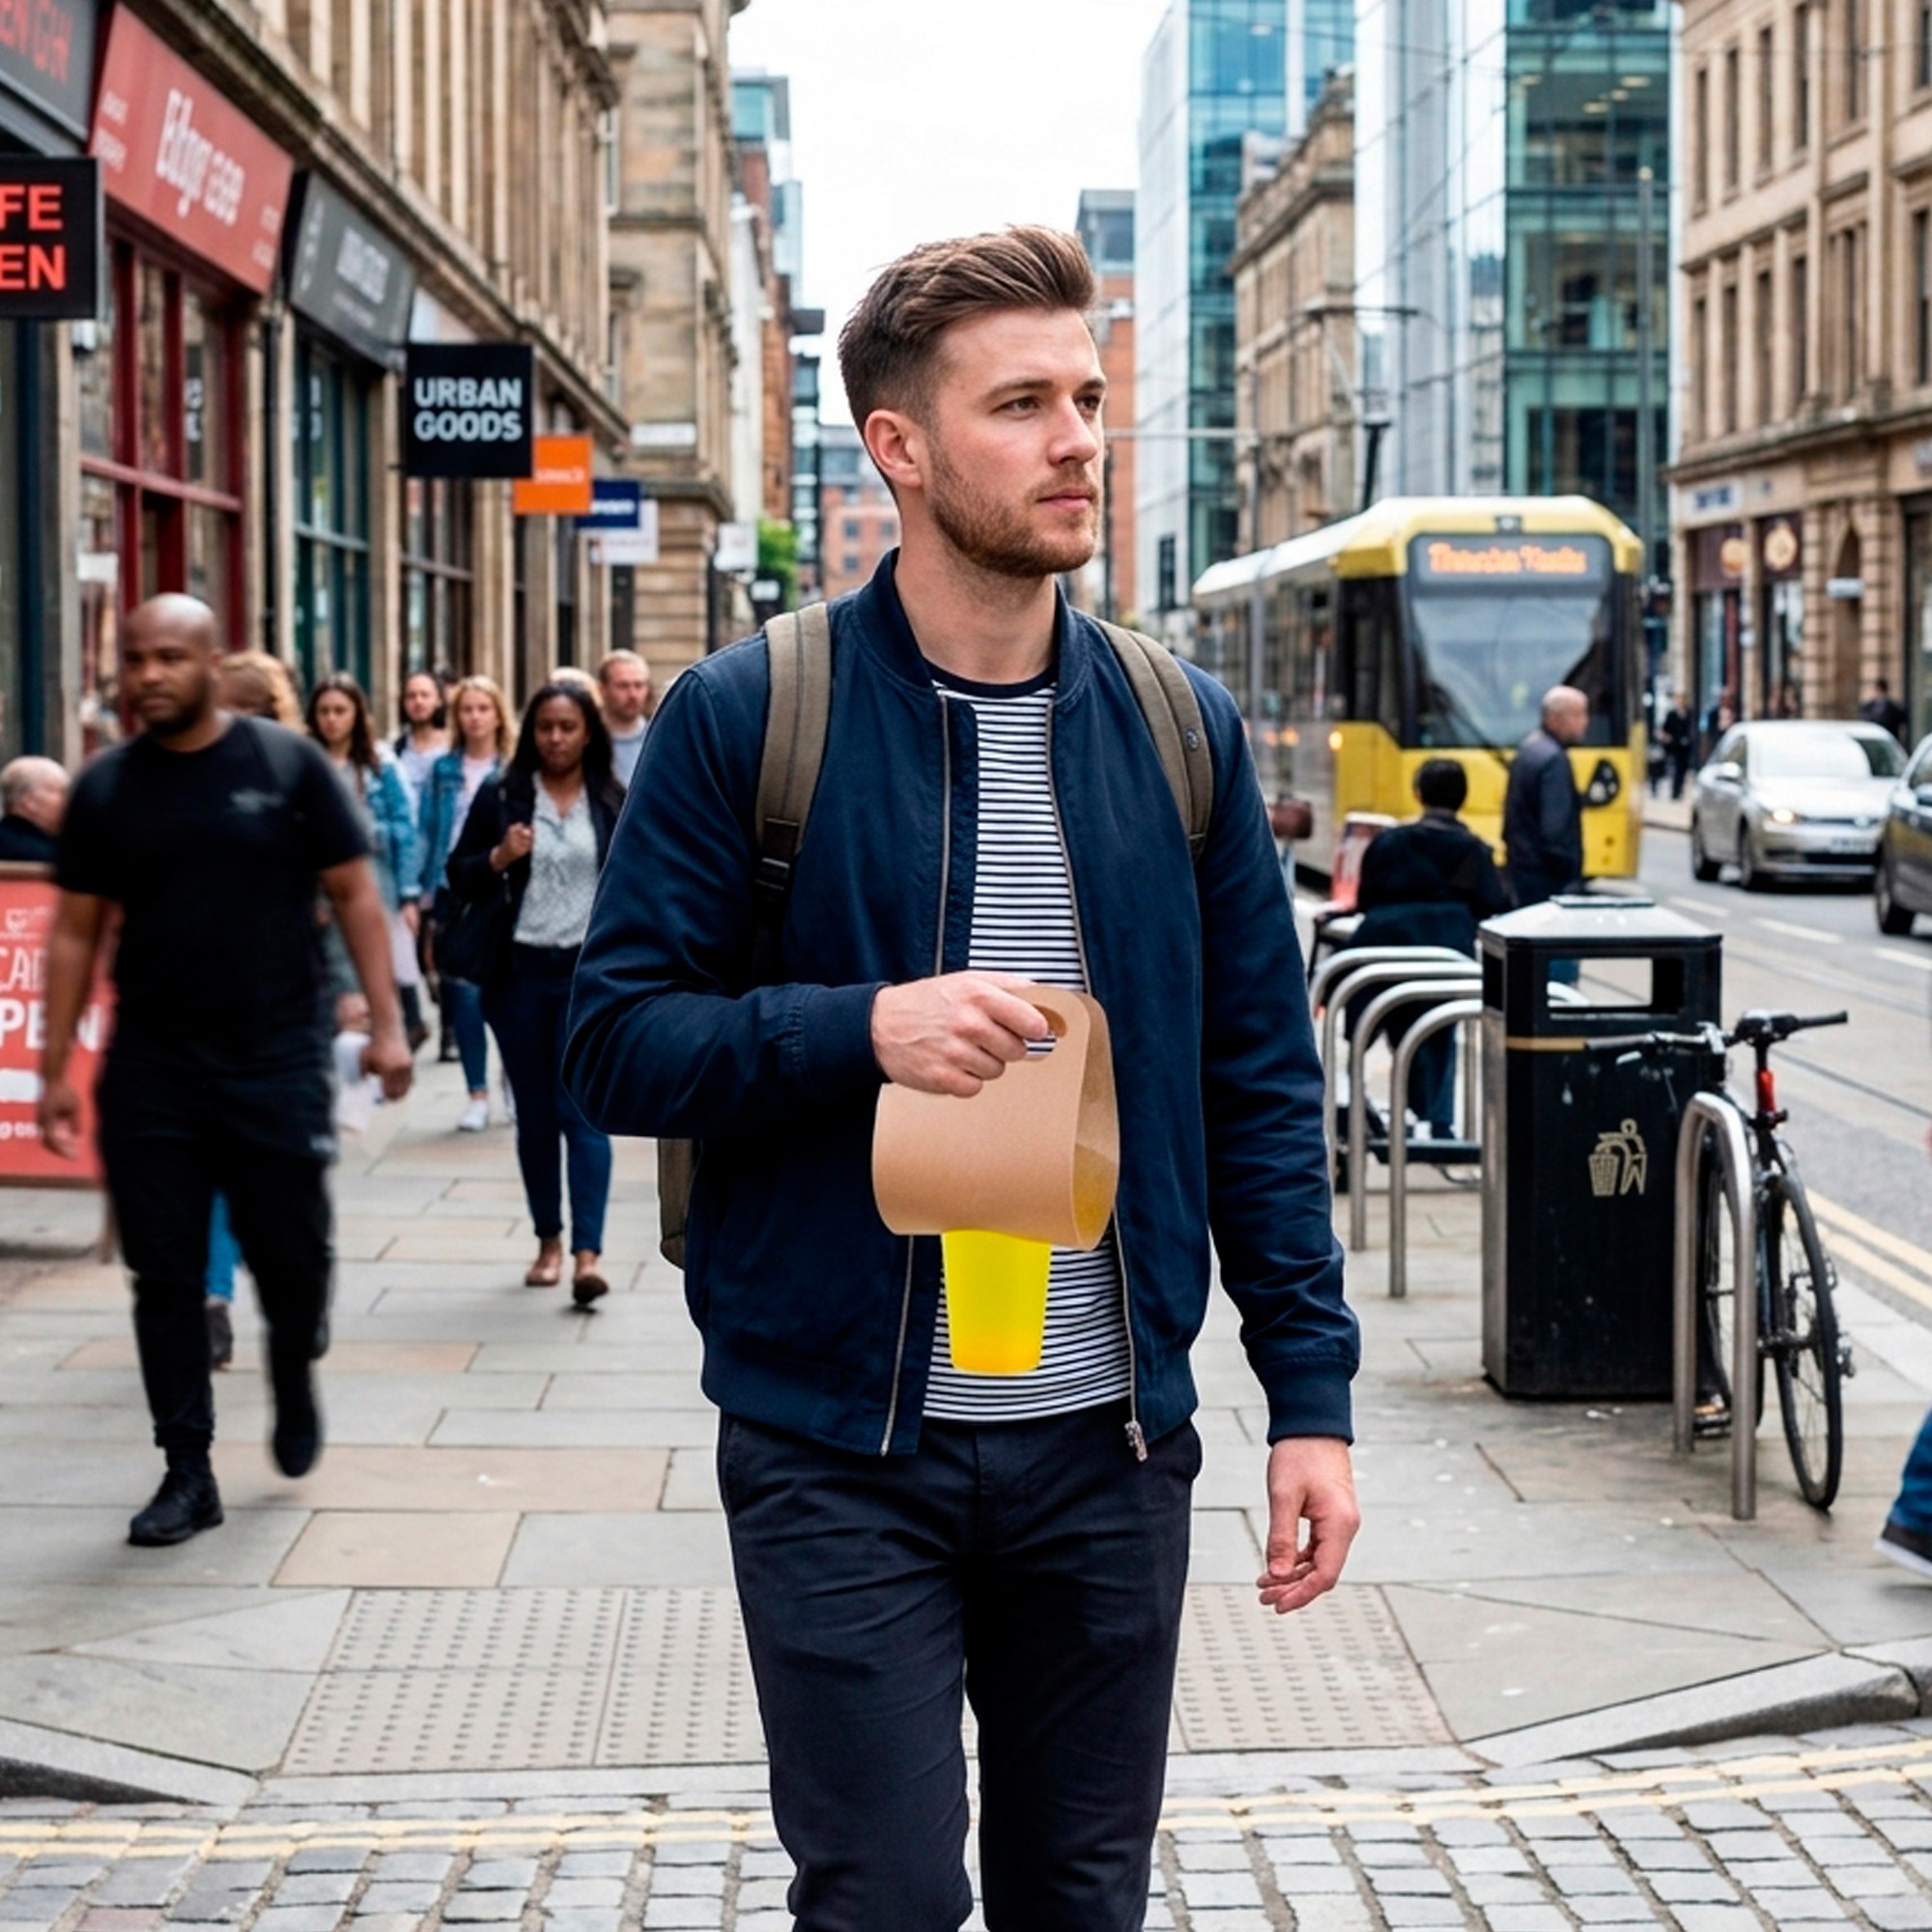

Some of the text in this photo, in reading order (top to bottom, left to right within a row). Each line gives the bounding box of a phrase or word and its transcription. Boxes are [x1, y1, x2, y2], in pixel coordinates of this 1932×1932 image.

[0, 185, 63, 230] FE
[0, 244, 66, 290] EN
[413, 377, 523, 408] URBAN
[413, 410, 524, 441] GOODS
